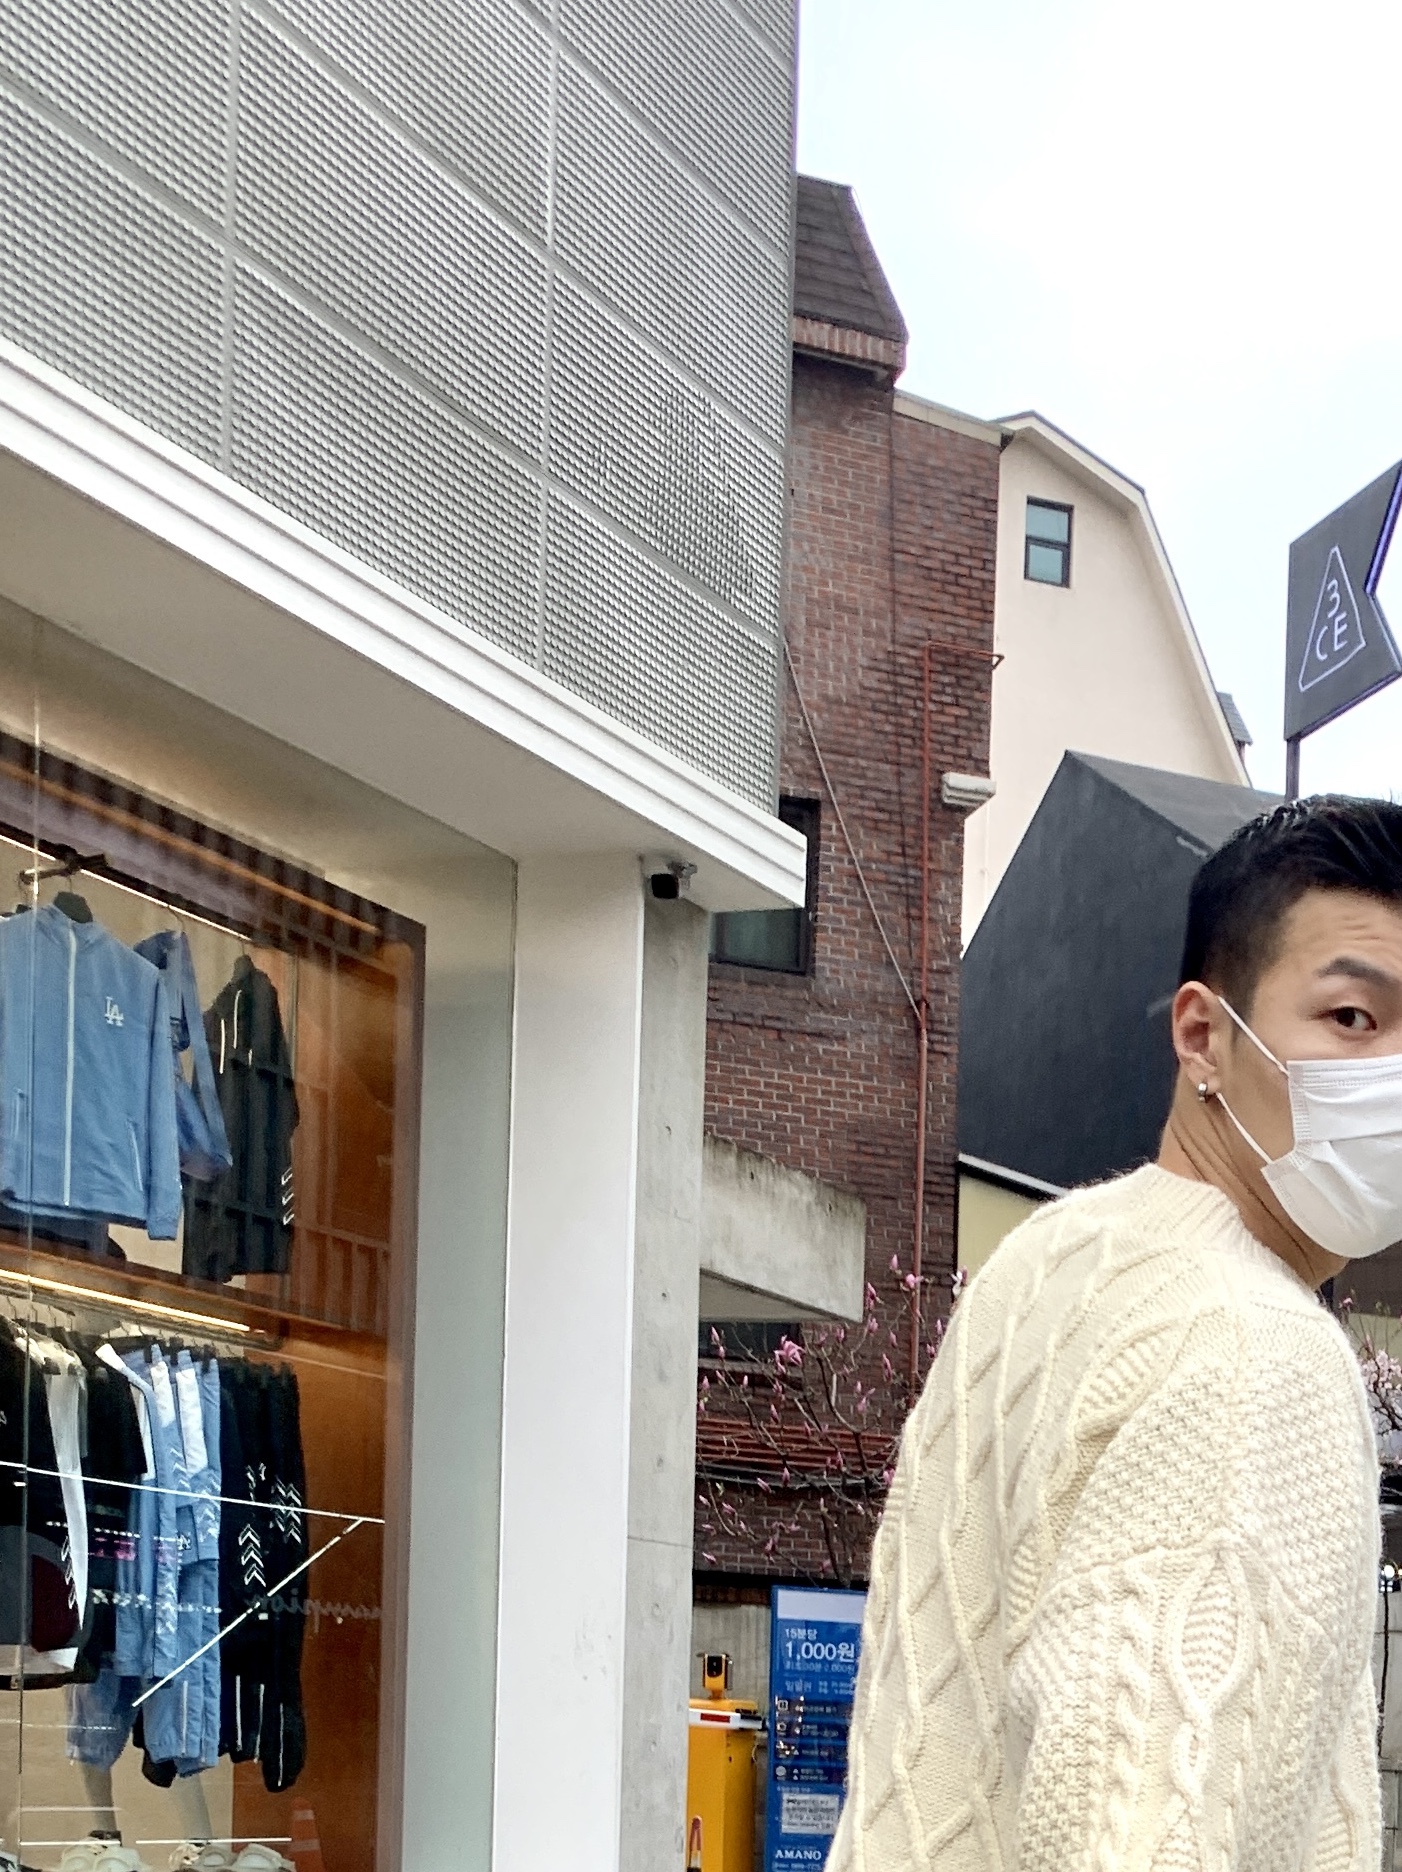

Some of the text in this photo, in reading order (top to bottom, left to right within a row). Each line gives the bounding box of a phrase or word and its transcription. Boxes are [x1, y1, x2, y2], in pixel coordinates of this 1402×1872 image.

[1327, 579, 1341, 618] 3
[1316, 611, 1348, 661] CE
[105, 996, 124, 1026] LA
[785, 1641, 855, 1663] 1,000원
[775, 1849, 822, 1861] AMANO
